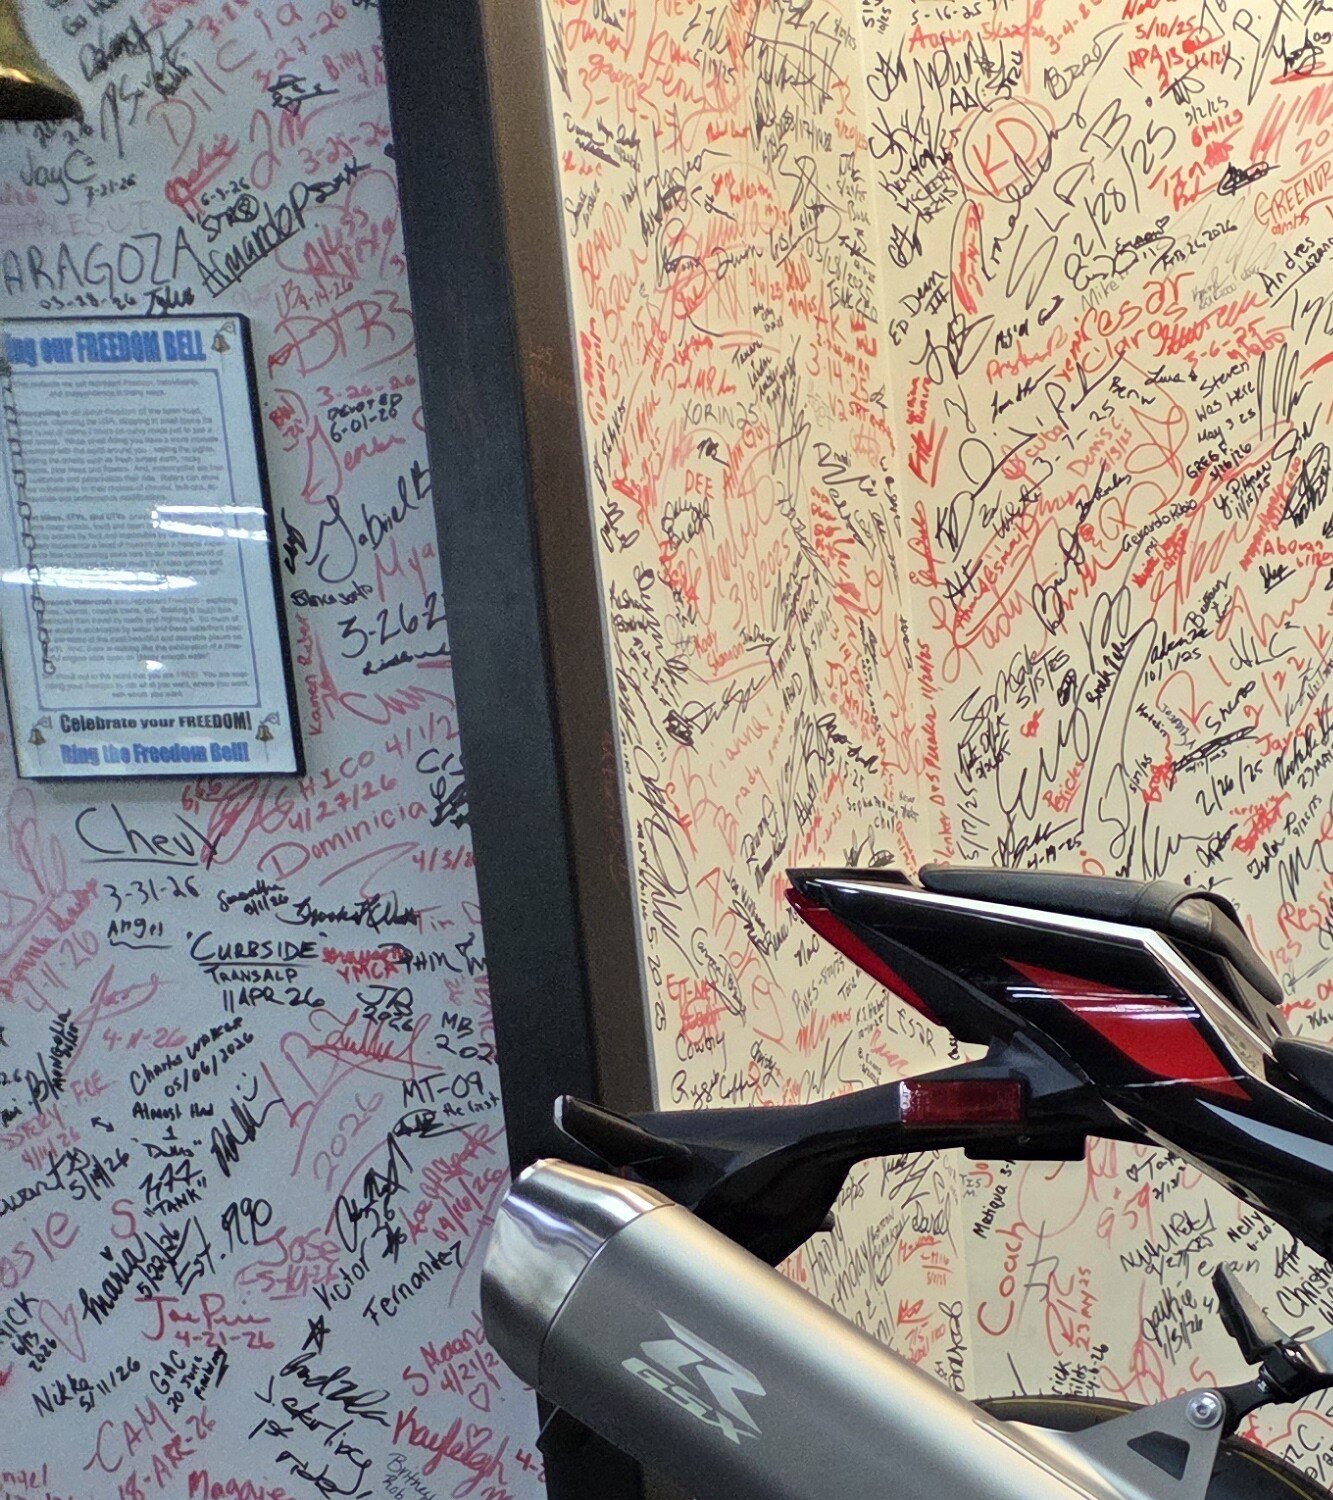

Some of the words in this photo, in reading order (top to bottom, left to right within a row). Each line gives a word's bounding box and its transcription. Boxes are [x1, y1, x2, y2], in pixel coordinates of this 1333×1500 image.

[75, 330, 161, 362] FREEDOM
[163, 330, 206, 362] BELL
[60, 713, 137, 733] Celebrate
[140, 716, 174, 729] your
[178, 711, 252, 730] FREEDOM!
[60, 744, 100, 765] Ring
[103, 744, 131, 764] the
[132, 743, 208, 763] Freedom
[103, 876, 200, 912] 3-31-26
[284, 987, 326, 1007] 26
[402, 1070, 484, 1109] MT-09
[977, 1222, 1027, 1336] Coach
